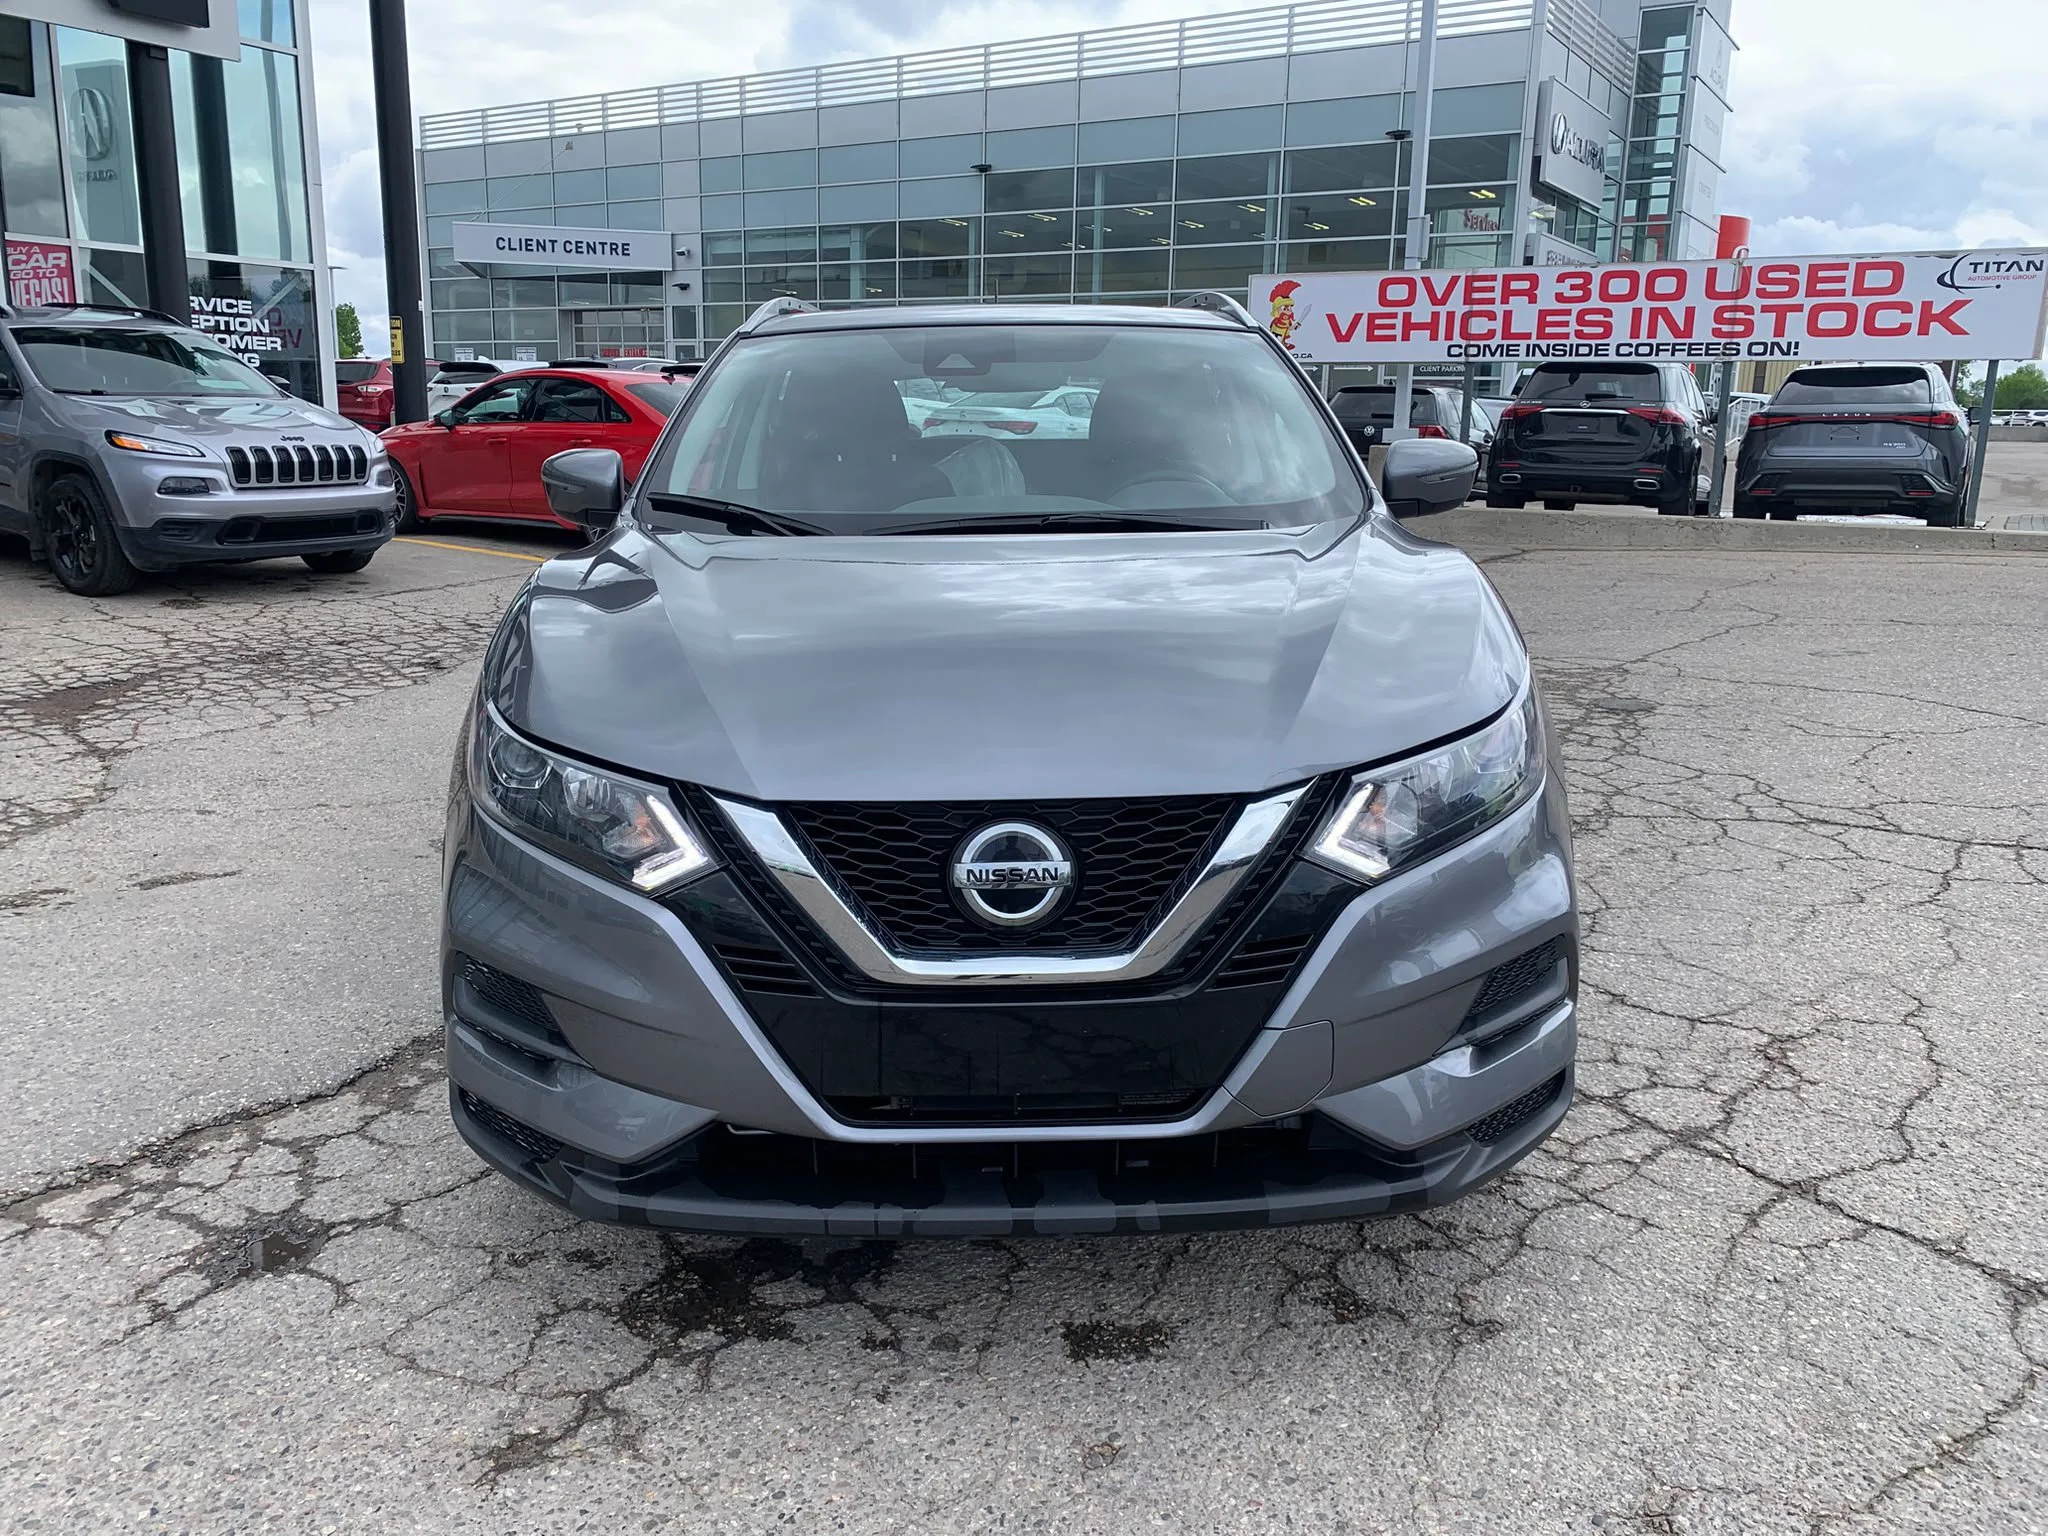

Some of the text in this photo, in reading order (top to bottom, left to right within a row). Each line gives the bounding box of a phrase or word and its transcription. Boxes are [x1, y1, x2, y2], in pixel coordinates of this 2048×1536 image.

[496, 237, 631, 256] CLIENT CENTRE
[8, 253, 67, 270] CAR
[1969, 260, 2044, 273] TITAN
[10, 269, 58, 279] GO TO
[1378, 261, 1905, 308] OVER 300 USED
[189, 296, 253, 314] RVICE
[191, 314, 270, 333] EPTION
[1325, 299, 1975, 343] VEHICLES IN STOCK
[1447, 341, 1800, 358] COME INSIDE COFFEES ON!
[966, 867, 1059, 883] NISSAN
